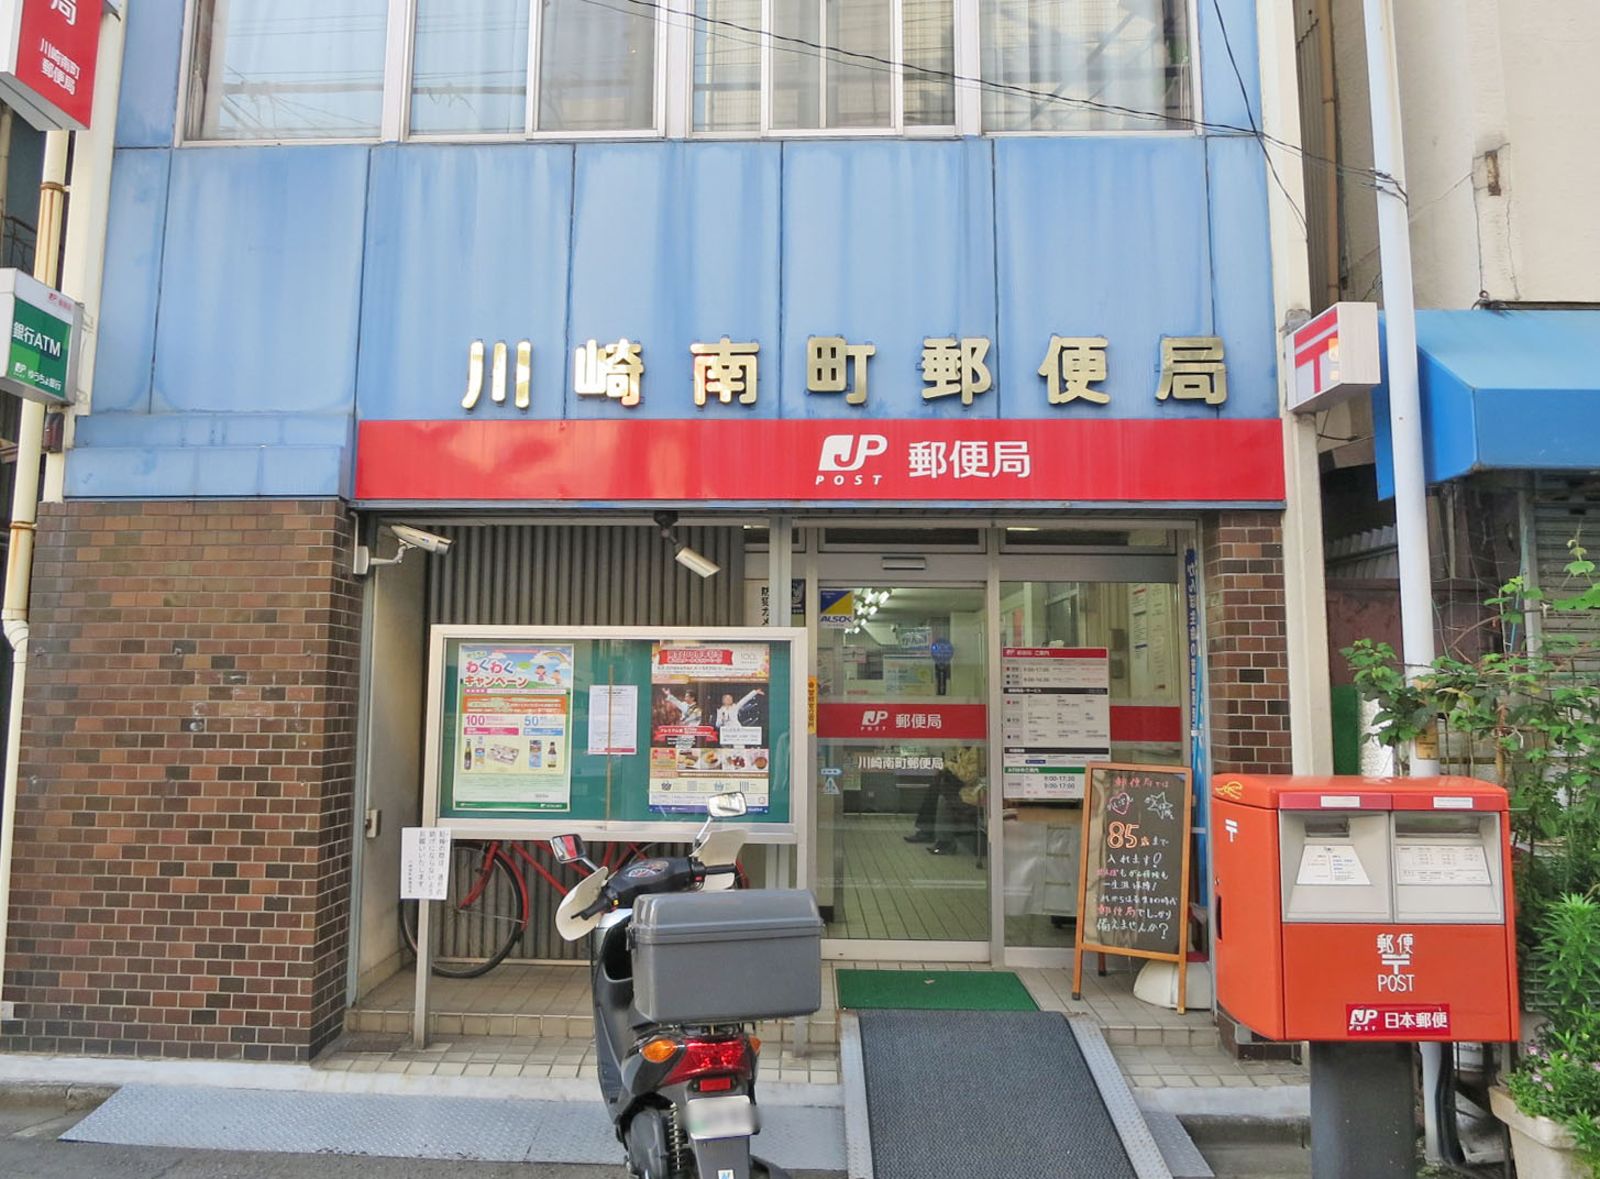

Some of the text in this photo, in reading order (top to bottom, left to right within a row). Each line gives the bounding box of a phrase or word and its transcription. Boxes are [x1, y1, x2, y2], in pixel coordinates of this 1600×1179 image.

[40, 37, 81, 80] 川崎南町
[41, 57, 76, 96] 郵便局
[13, 321, 61, 358] 銀行ATM
[28, 369, 62, 391] ゆうちょ銀行
[460, 335, 1228, 409] 川崎南町郵便局
[907, 439, 1031, 479] 郵便局
[815, 474, 883, 486] POST
[466, 660, 514, 674] わくわく
[465, 676, 529, 687] キャンペーン
[466, 715, 485, 726] 100
[524, 716, 539, 726] 50
[895, 713, 942, 729] 郵便局
[858, 755, 944, 770] 川崎南町郵便局
[1113, 776, 1169, 788] 郵便局では
[1376, 933, 1414, 955] 郵便
[1377, 974, 1416, 993] POST
[1384, 1010, 1448, 1029] 日本郵便
